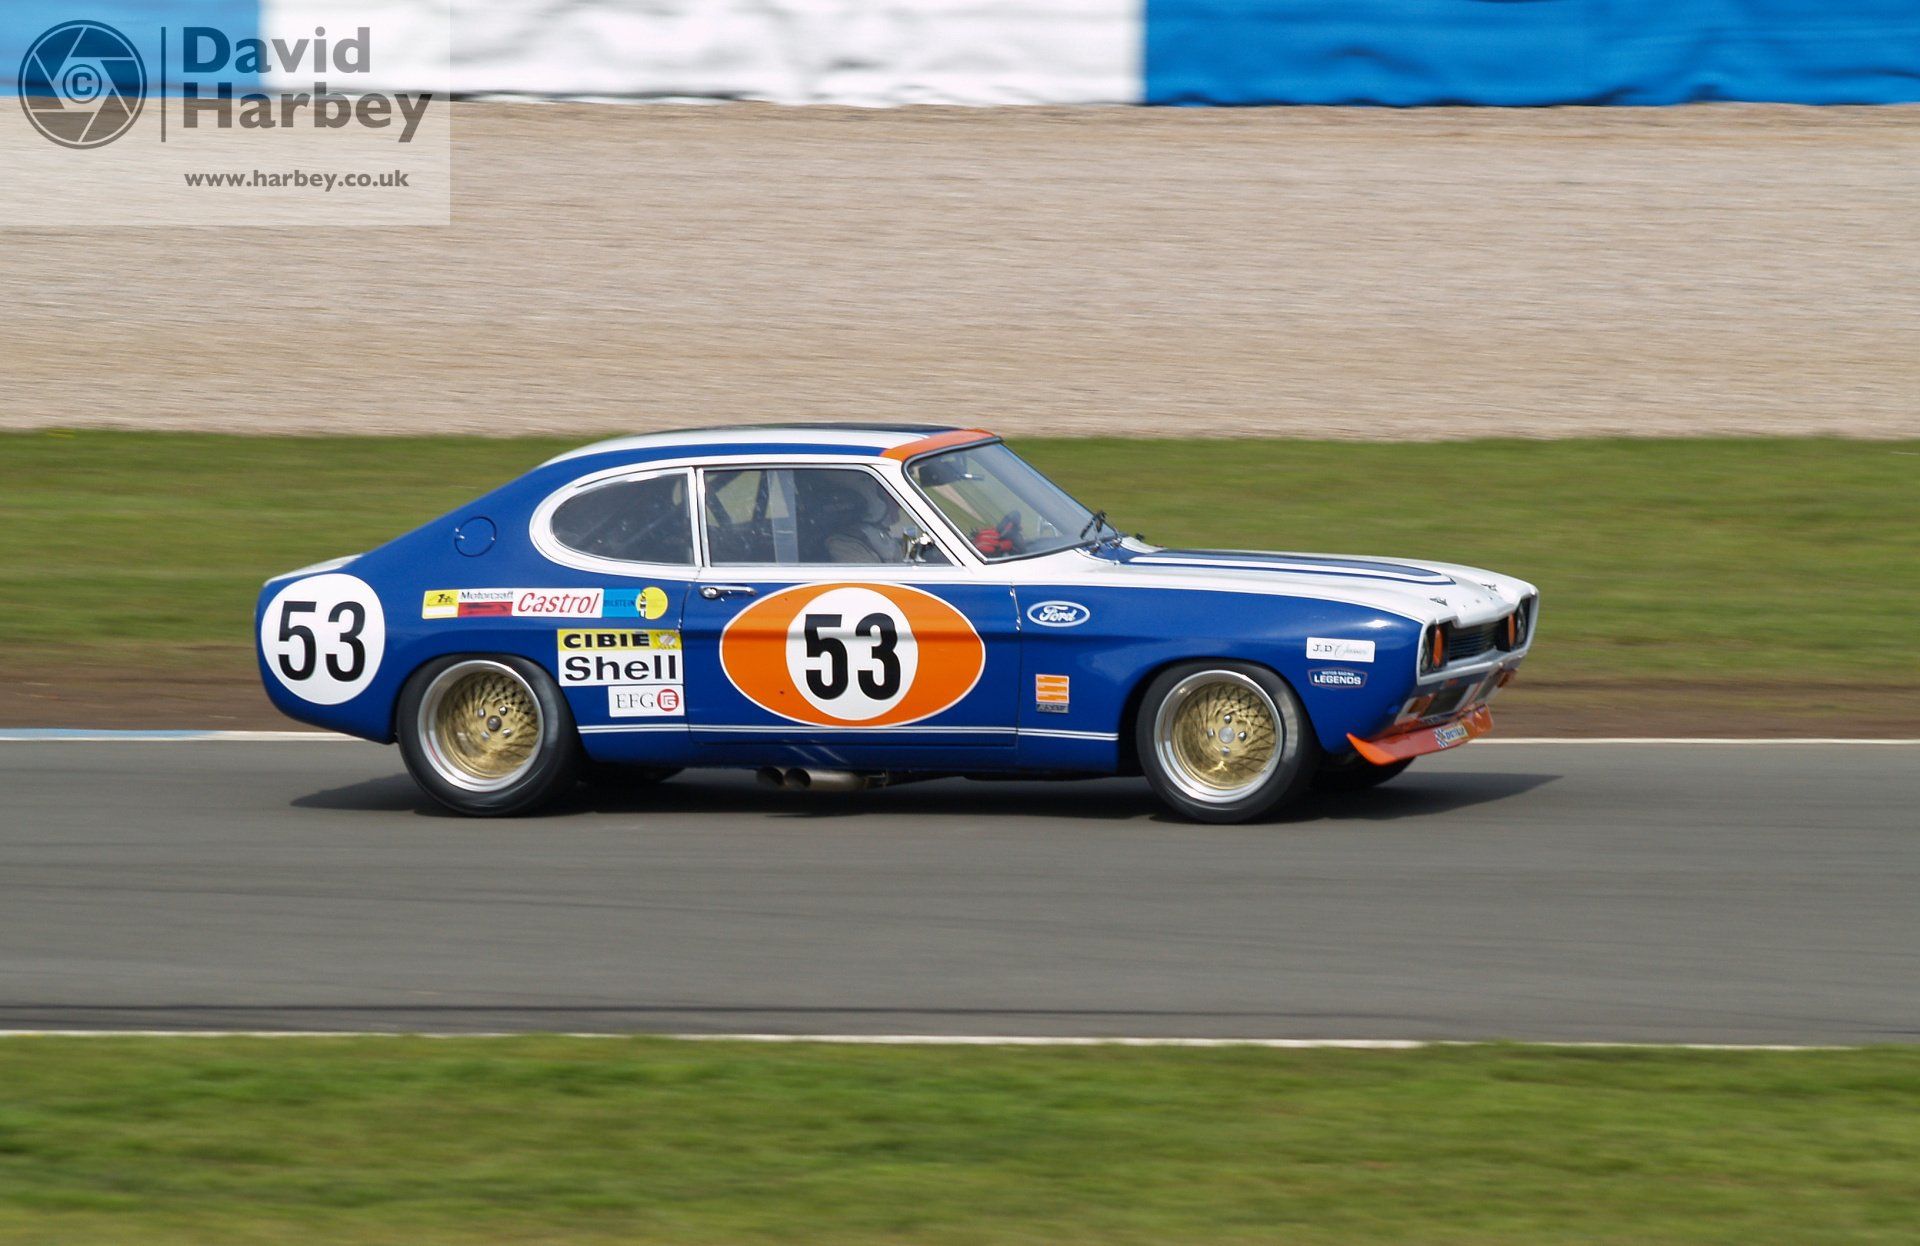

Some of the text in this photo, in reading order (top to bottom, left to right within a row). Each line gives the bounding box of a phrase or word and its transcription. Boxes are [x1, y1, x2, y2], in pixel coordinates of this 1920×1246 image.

[460, 591, 514, 600] Motorcraft
[517, 592, 601, 614] Castrol
[1039, 605, 1078, 622] Ford
[278, 600, 366, 682] 53
[563, 633, 650, 649] CIBIE
[804, 612, 901, 700] 53
[564, 654, 677, 682] Shell
[1313, 674, 1361, 685] LEGENDS
[616, 692, 654, 709] EFG
